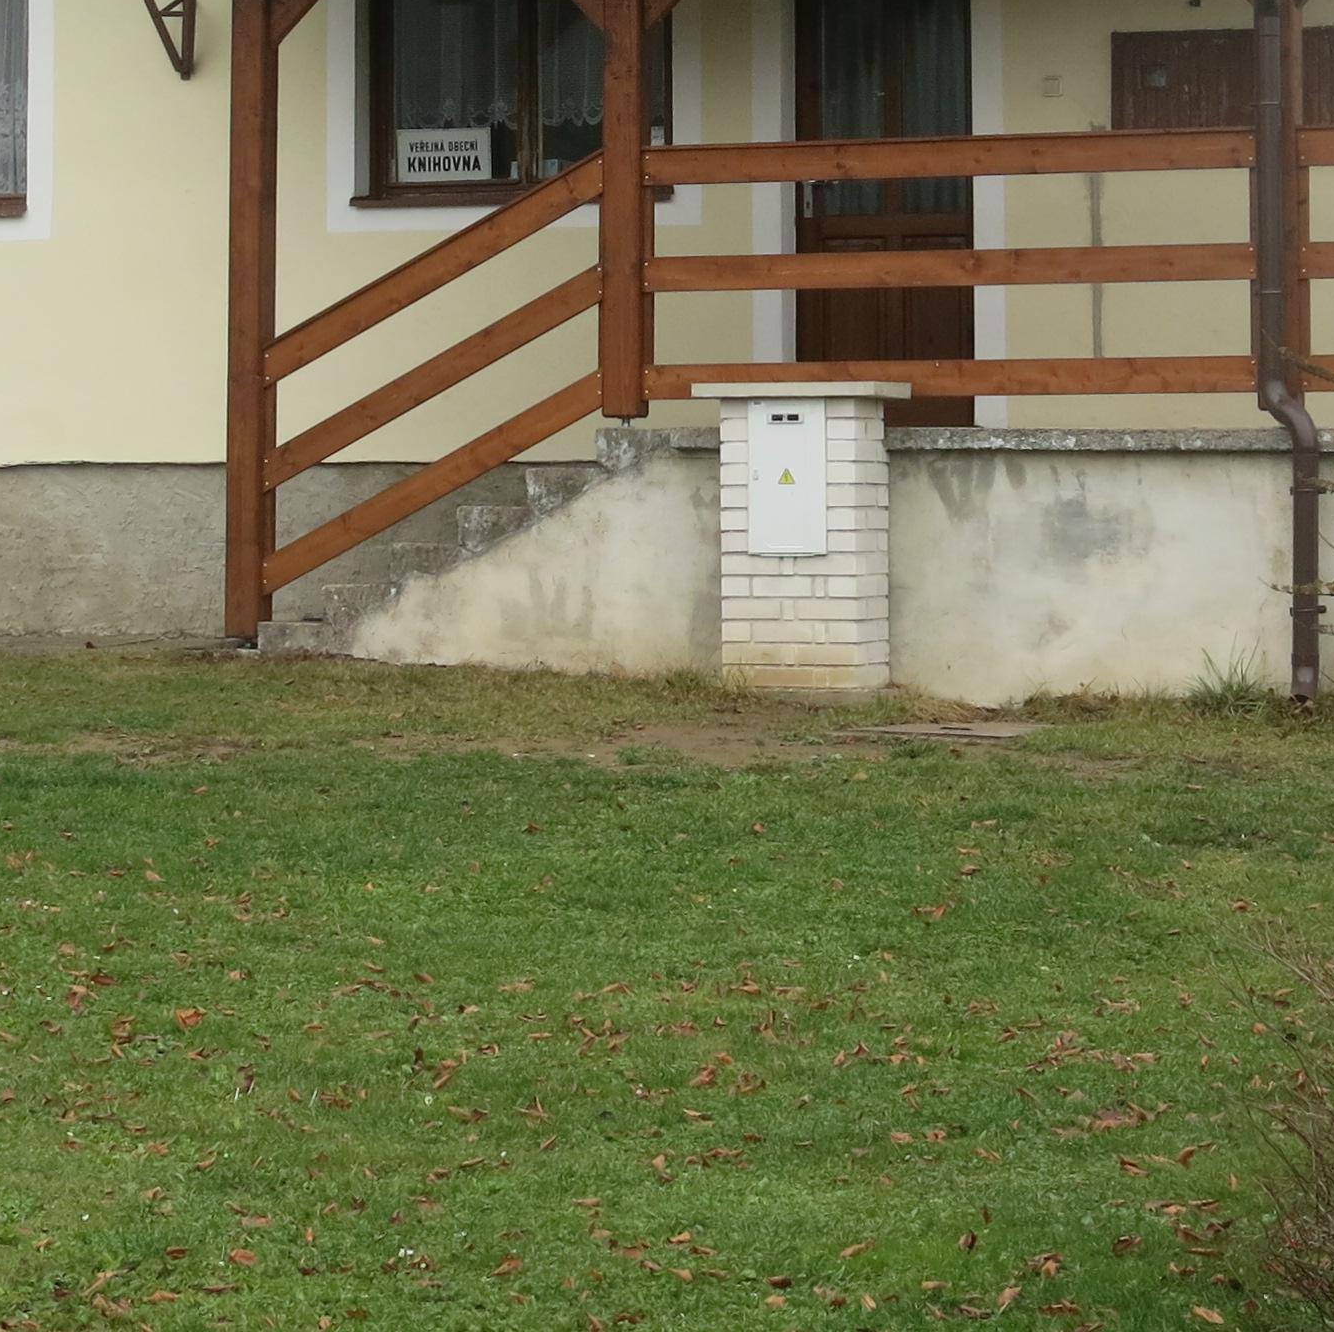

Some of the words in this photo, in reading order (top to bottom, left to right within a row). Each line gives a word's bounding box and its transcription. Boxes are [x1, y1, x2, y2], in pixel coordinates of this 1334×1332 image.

[409, 140, 445, 153] VEŘEJNÁ
[448, 139, 478, 152] OBECNÍ
[407, 155, 482, 173] KNIHOVNA
